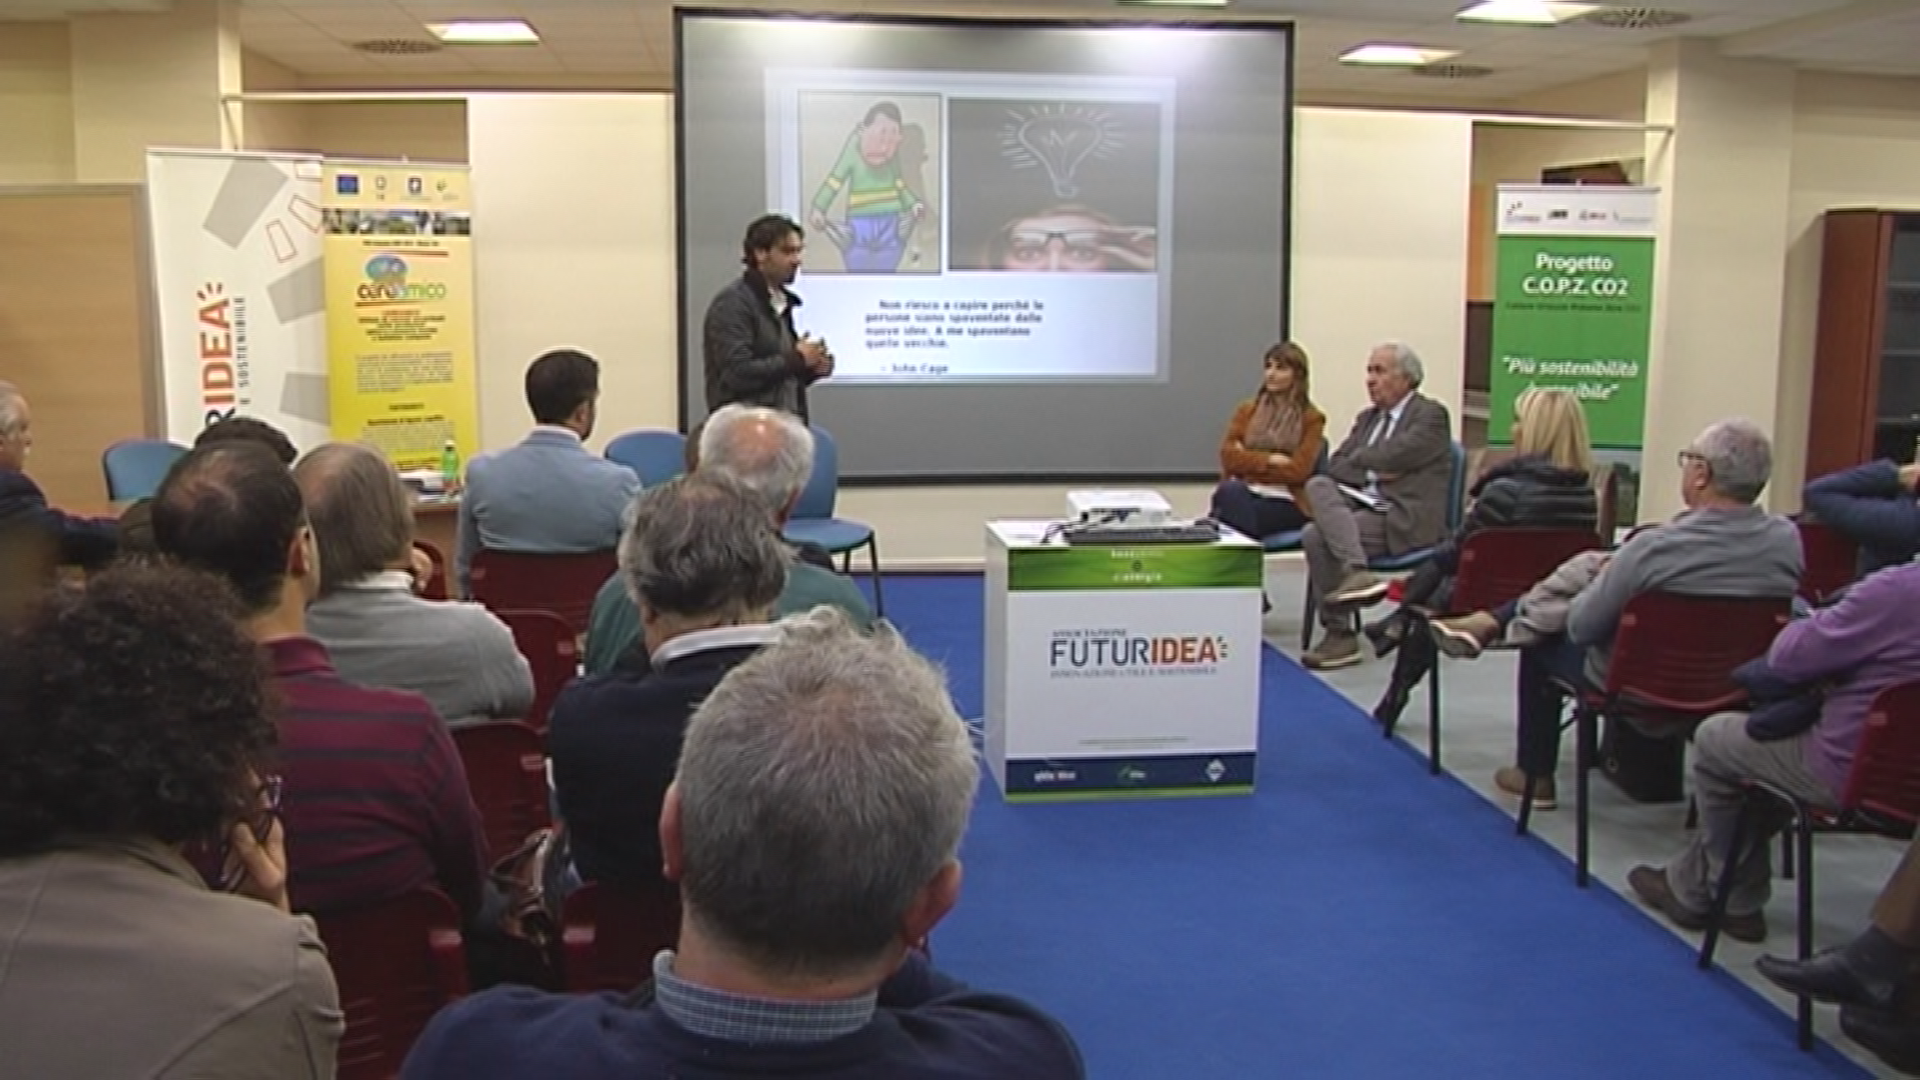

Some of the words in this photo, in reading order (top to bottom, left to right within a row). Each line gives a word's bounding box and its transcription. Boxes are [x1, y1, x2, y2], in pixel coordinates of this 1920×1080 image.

[1535, 252, 1614, 275] Progetto
[1522, 276, 1589, 295] C.O.P.Z.
[879, 300, 902, 310] Non
[865, 314, 911, 324] persone
[1050, 637, 1218, 667] FUTURIDEA
